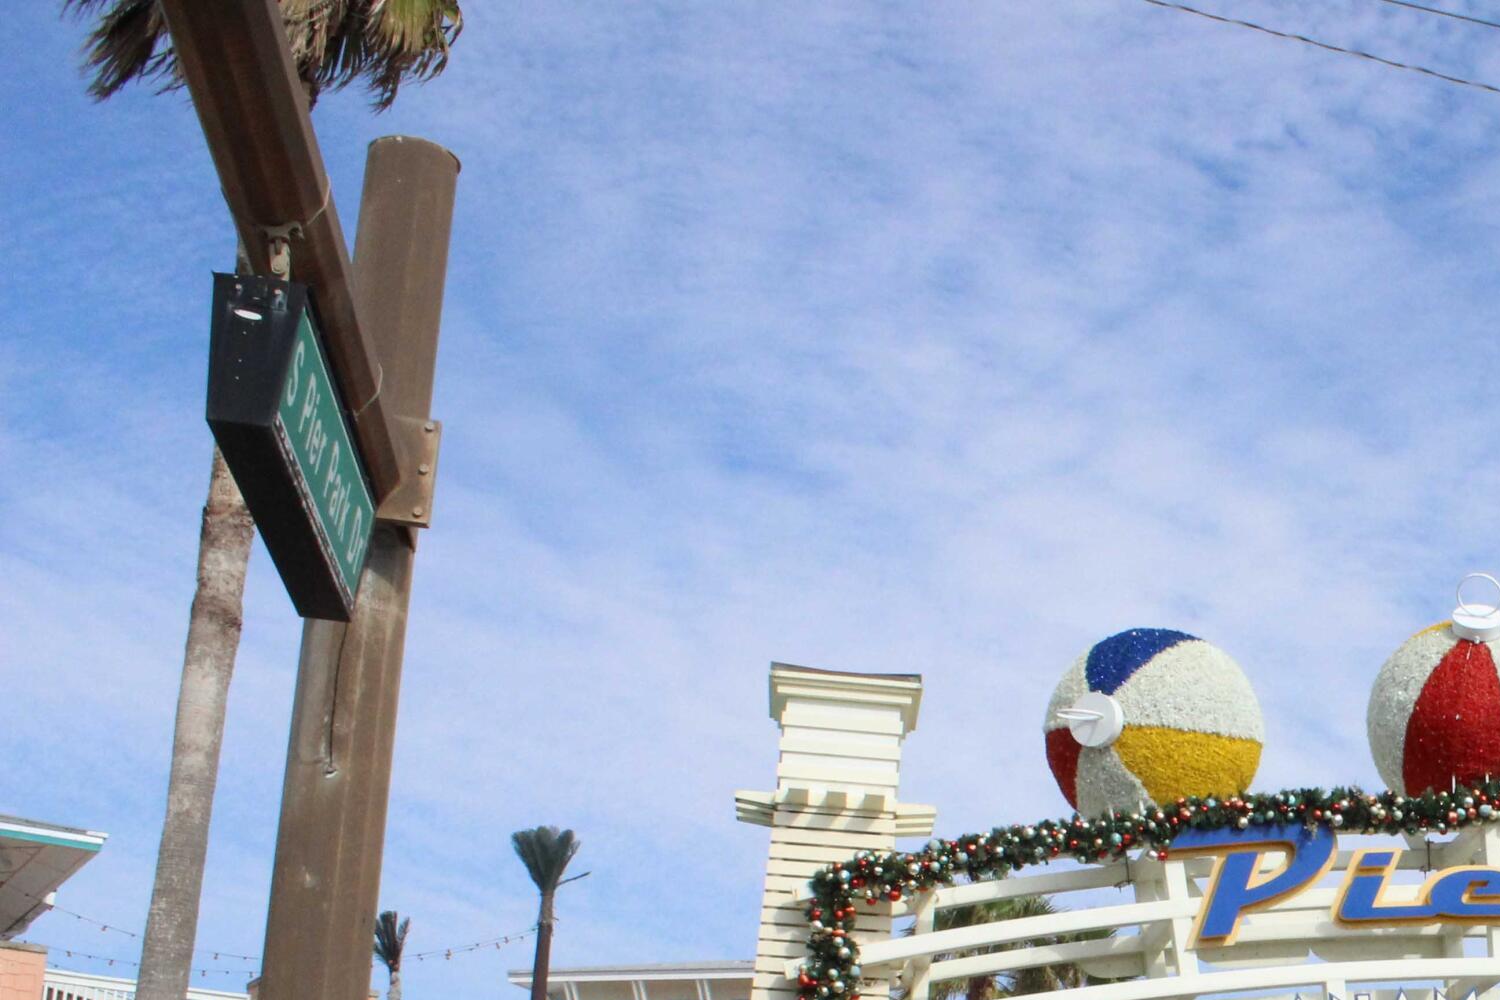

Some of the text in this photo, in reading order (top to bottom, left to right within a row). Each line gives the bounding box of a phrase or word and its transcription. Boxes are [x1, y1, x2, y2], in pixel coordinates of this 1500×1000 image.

[287, 340, 364, 574] S Pier Park Dr
